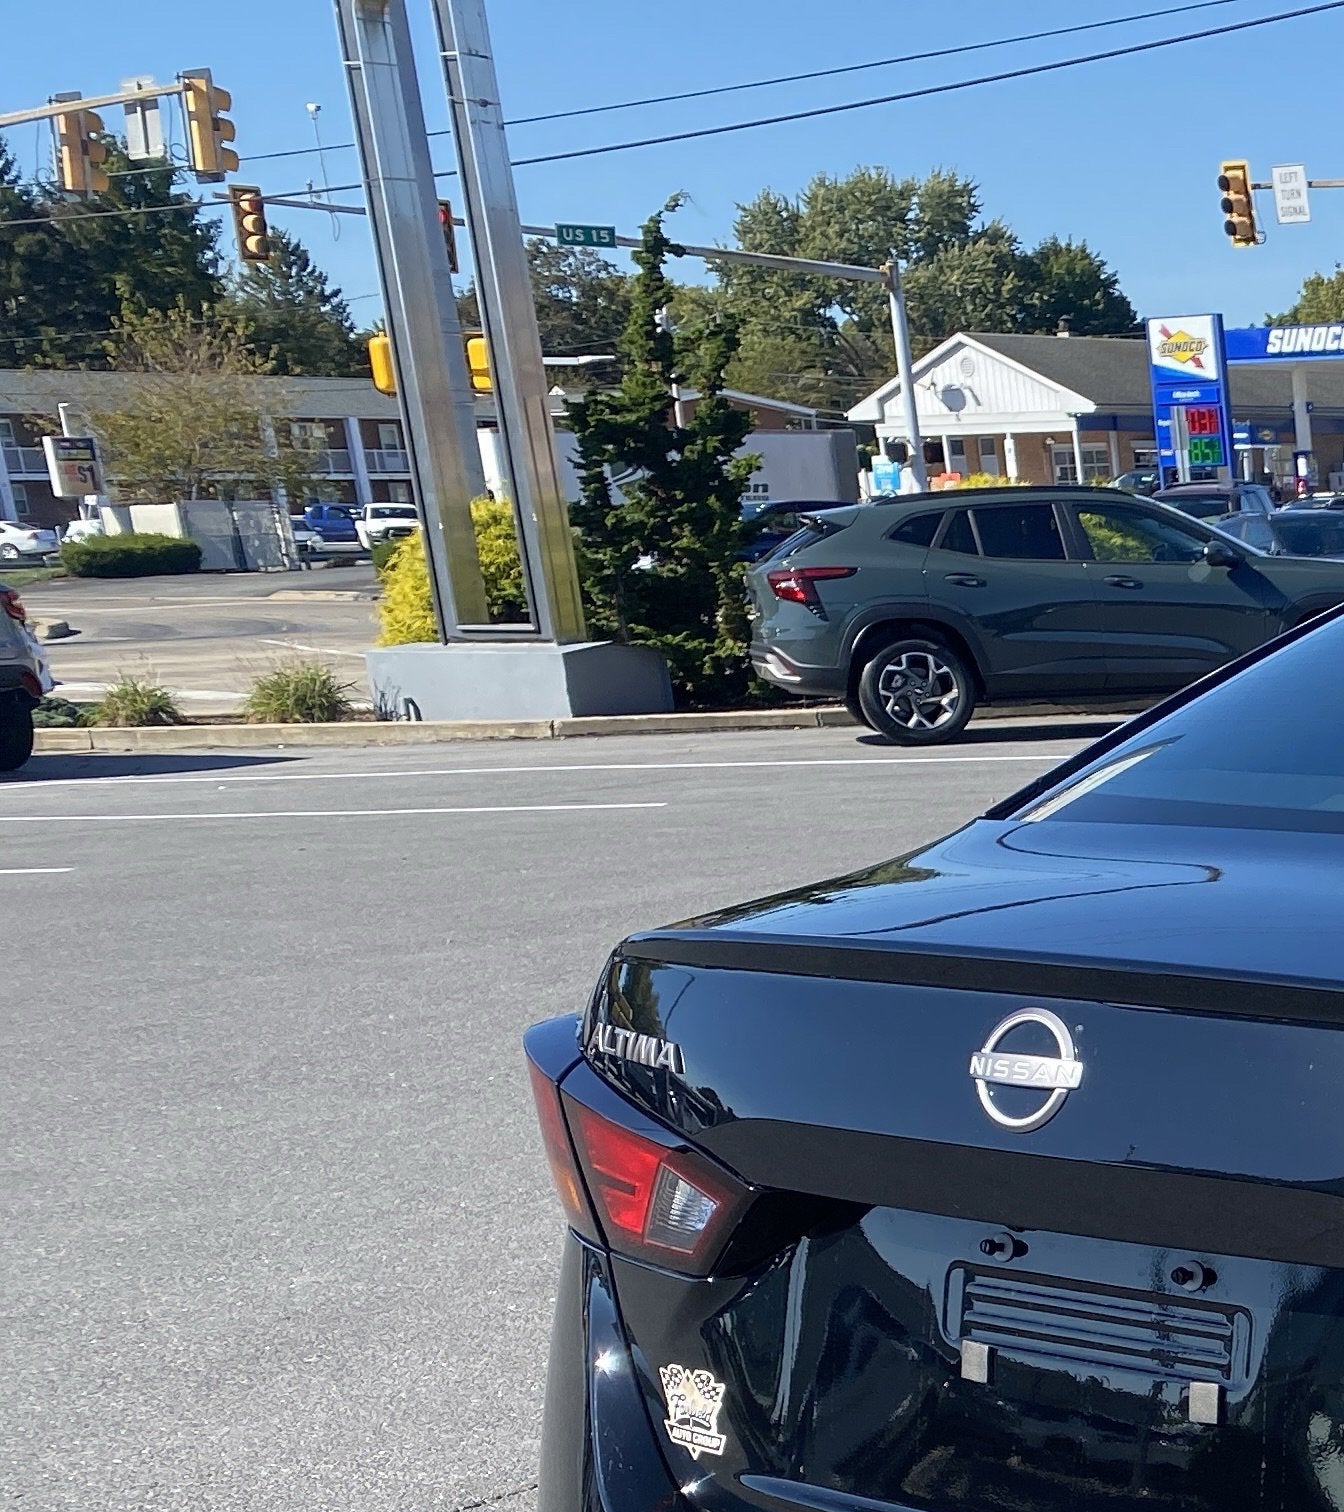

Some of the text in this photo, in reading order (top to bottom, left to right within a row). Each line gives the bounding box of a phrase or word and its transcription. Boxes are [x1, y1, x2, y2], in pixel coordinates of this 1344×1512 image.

[1279, 172, 1298, 184] LEFT
[1281, 188, 1302, 200] TURN
[1280, 206, 1308, 217] SIGNAL
[562, 228, 610, 243] US 15
[1161, 340, 1203, 354] SUNOCO
[587, 1022, 676, 1074] ALTIMA
[969, 1056, 1077, 1085] NISSAN
